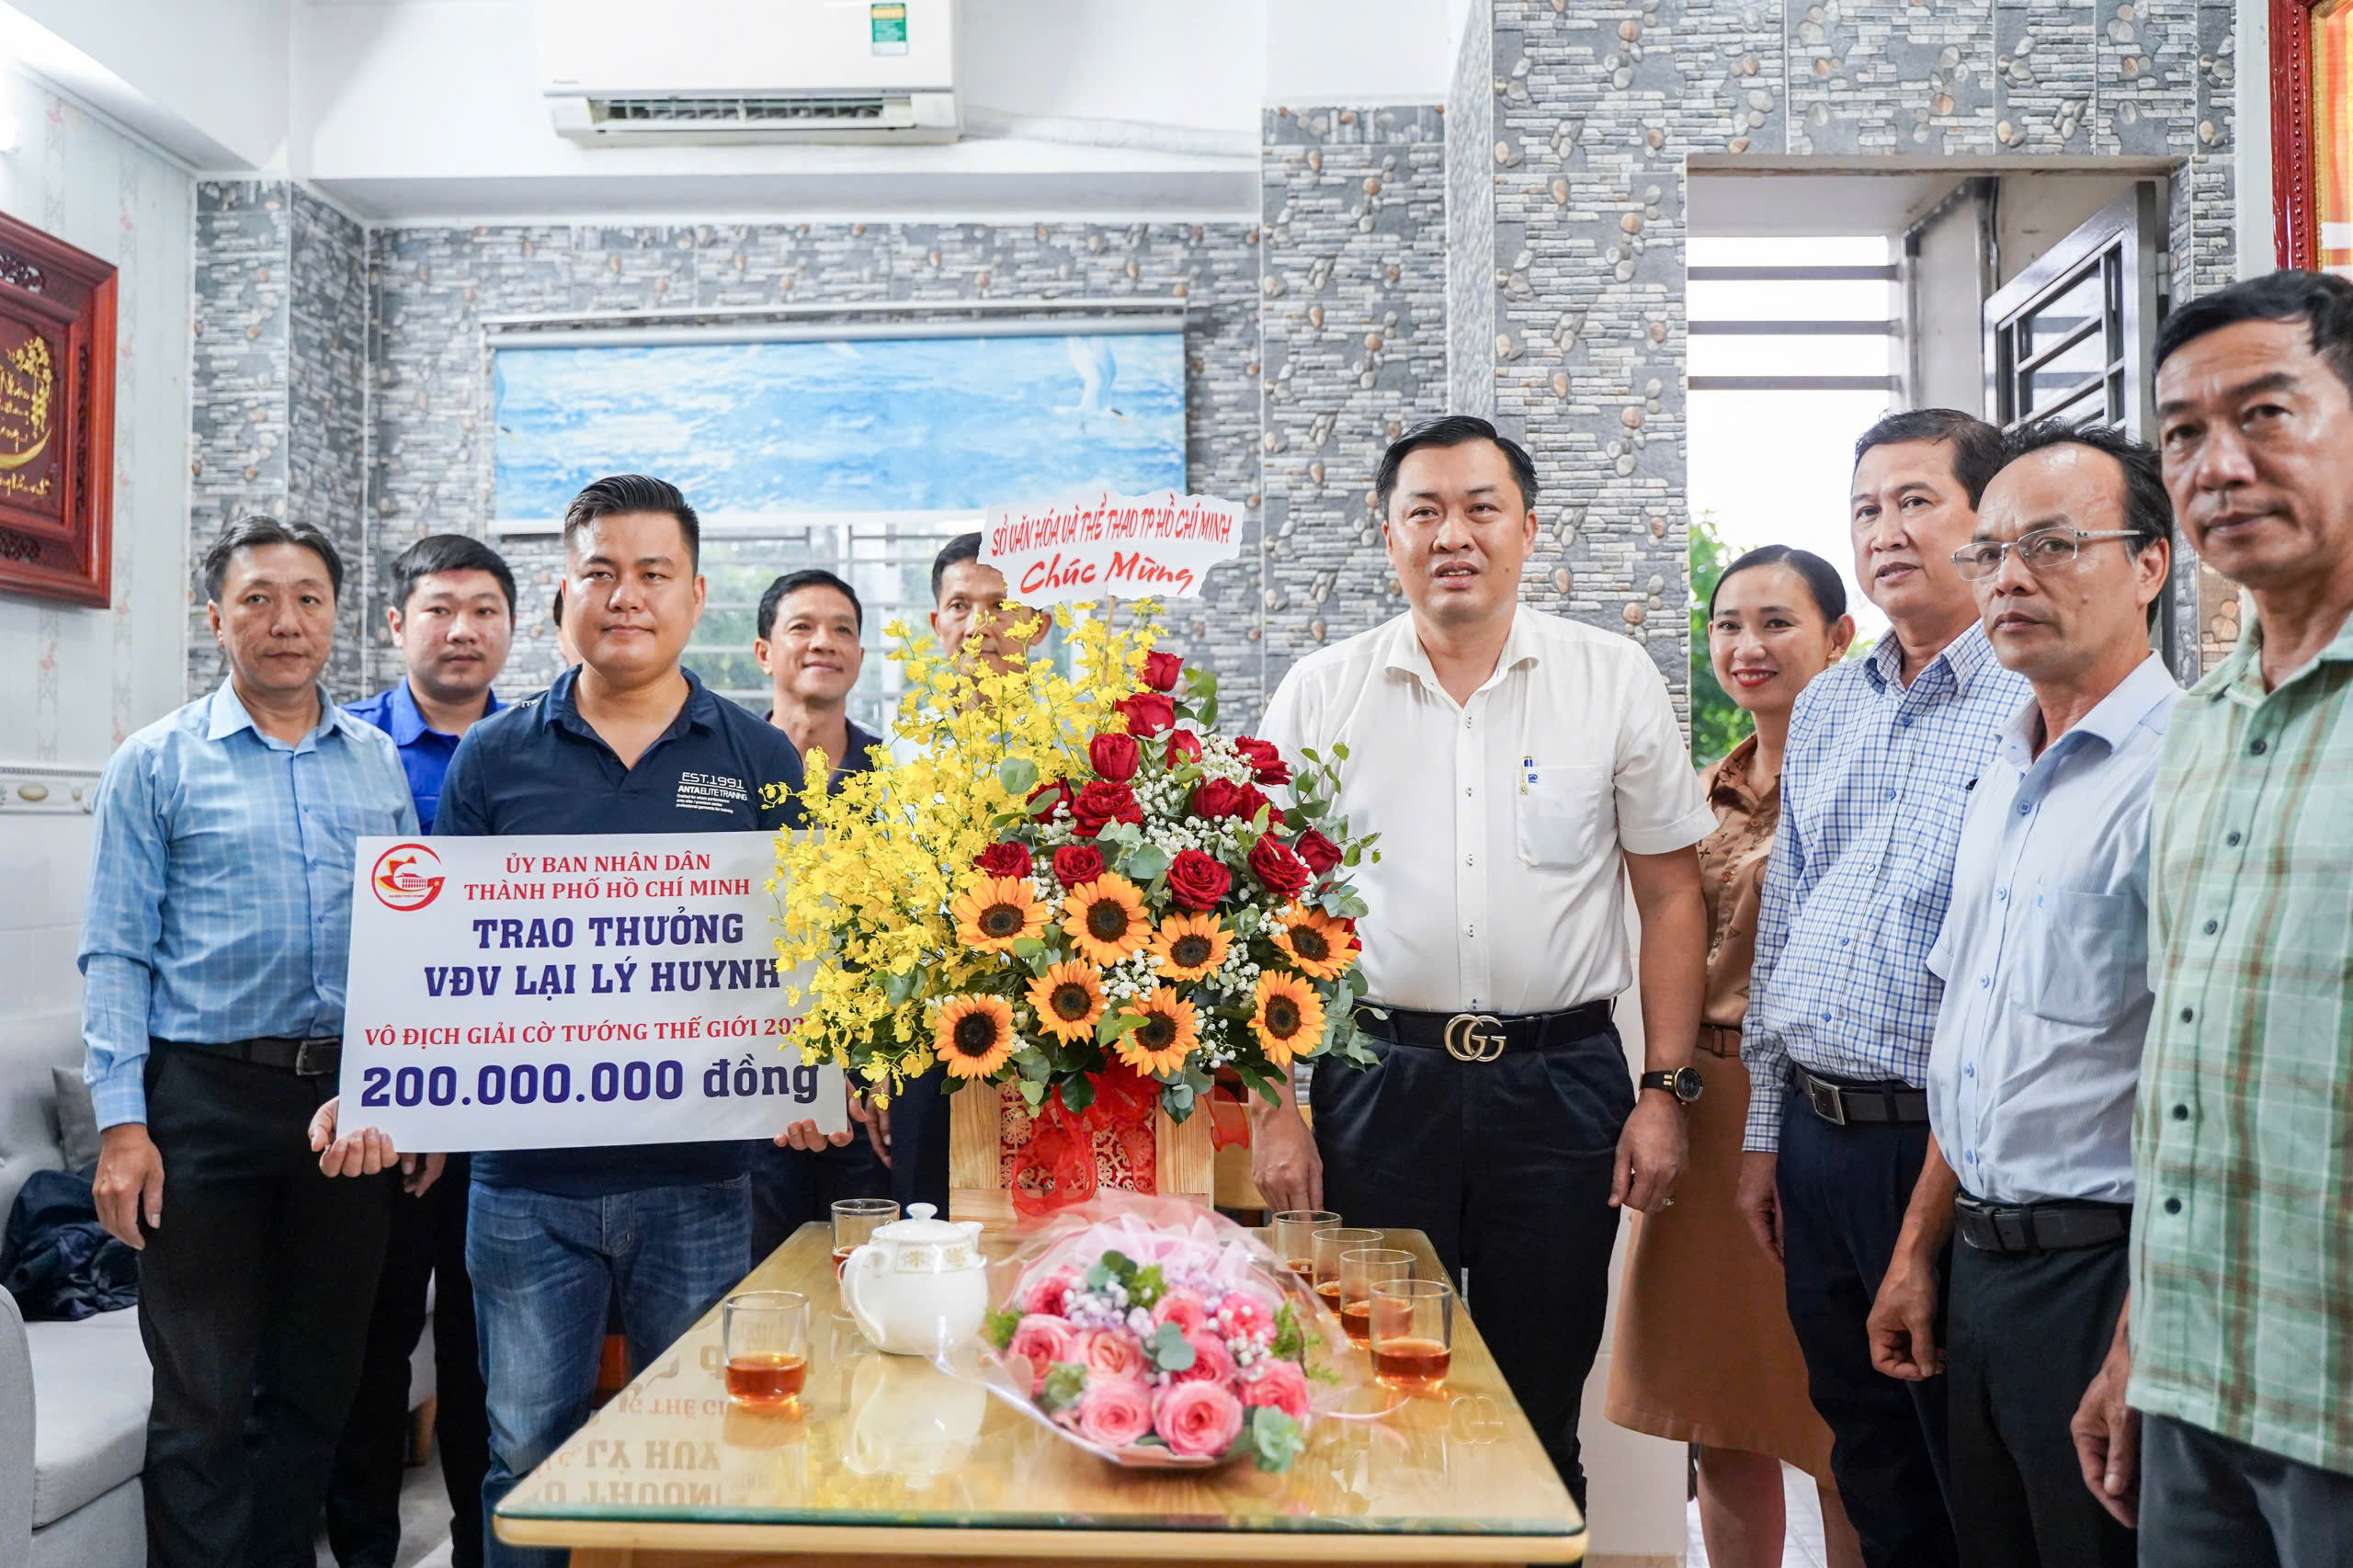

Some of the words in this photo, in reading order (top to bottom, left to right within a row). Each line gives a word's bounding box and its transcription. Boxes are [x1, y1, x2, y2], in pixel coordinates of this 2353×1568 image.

[992, 513, 1008, 557] SỞ
[1034, 508, 1061, 550] HÓA
[1062, 504, 1080, 543] VÀ
[1080, 492, 1107, 543] THỂ
[1106, 508, 1139, 540] THAO
[1140, 508, 1155, 540] TP
[1155, 493, 1175, 539] HỒ
[1176, 502, 1200, 540] CHÍ
[1198, 510, 1233, 544] MINH
[1020, 552, 1097, 594] Chúc
[1104, 551, 1194, 596] Mừng
[677, 785, 700, 793] ANTA
[682, 772, 745, 790] EST.1991
[506, 852, 536, 874] ỦY
[541, 856, 587, 874] BAN
[594, 850, 658, 873] NHÂN
[665, 849, 711, 871] DÂN
[463, 879, 545, 901] THÀNH
[551, 877, 600, 900] PHỐ
[606, 876, 639, 898] HỒ
[644, 876, 684, 898] CHÍ
[689, 879, 750, 897] MINH
[472, 917, 574, 949] TRAO
[588, 906, 743, 947] THƯỞNG
[424, 966, 502, 997] VĐV
[515, 963, 575, 1002] LẠI
[591, 956, 637, 994] LÝ
[651, 958, 780, 992] HUYNH
[364, 1024, 396, 1046] VÔ
[403, 1027, 460, 1051] ĐỊCH
[466, 1021, 516, 1045] GIẢI
[521, 1020, 556, 1044] CỜ
[561, 1017, 648, 1043] TƯỚNG
[654, 1016, 702, 1040] THẾ
[710, 1015, 758, 1039] GIỚI
[764, 1017, 805, 1036] 202
[361, 1060, 684, 1108] 200.000.000
[703, 1052, 819, 1105] đồng
